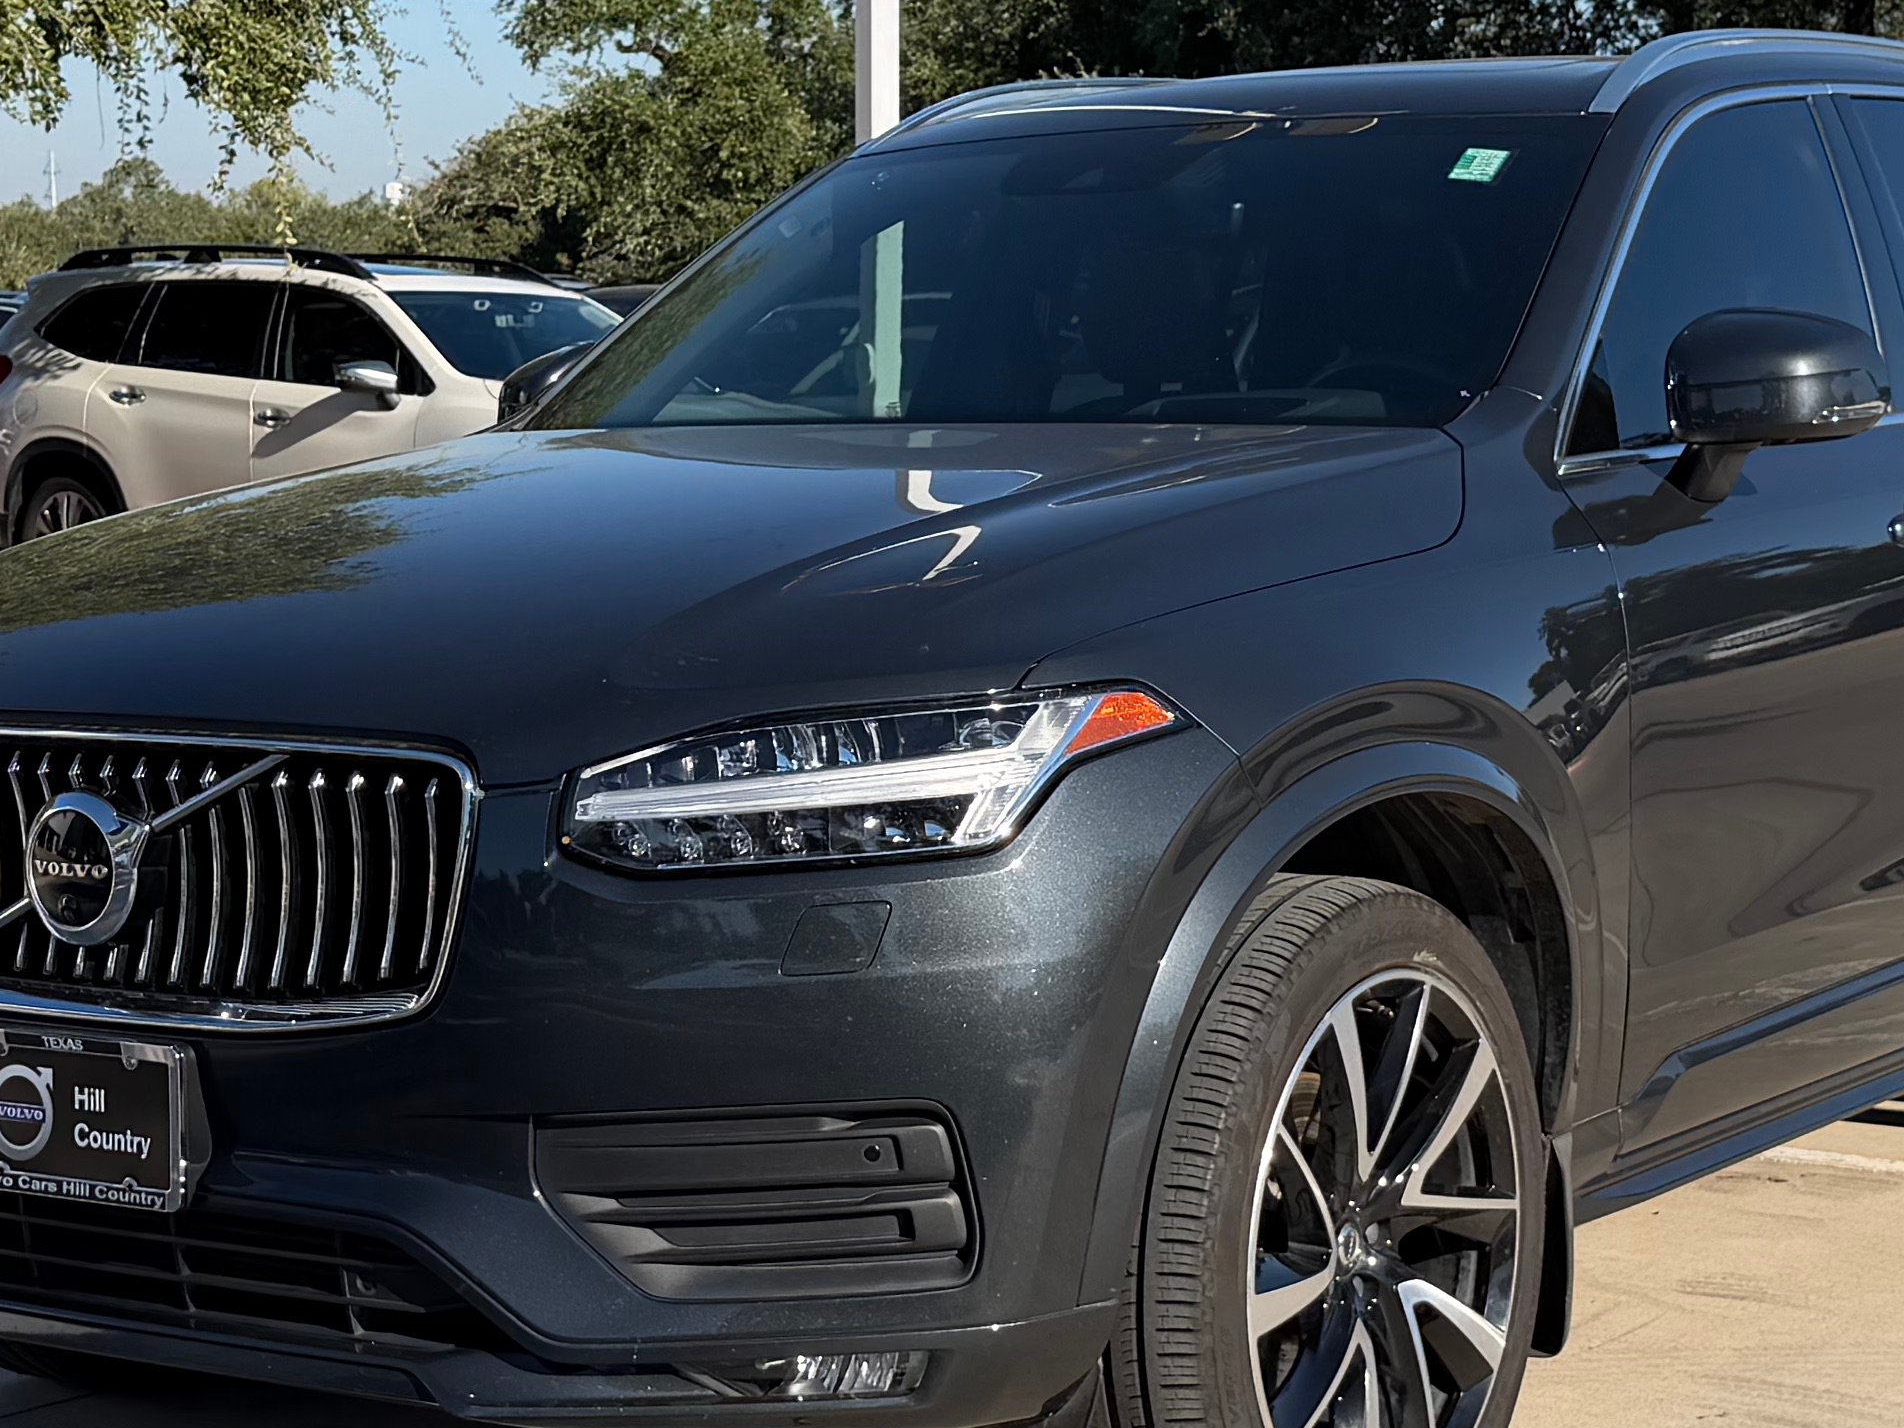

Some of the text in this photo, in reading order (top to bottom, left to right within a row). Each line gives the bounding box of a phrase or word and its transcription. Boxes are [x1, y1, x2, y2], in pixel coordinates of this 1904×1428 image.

[34, 859, 108, 880] VOLVO
[42, 1035, 84, 1052] TEXAS
[74, 1086, 105, 1113] Hill
[74, 1122, 151, 1159] Country
[17, 1175, 57, 1193] Cars
[62, 1181, 90, 1198] Hill
[94, 1185, 164, 1209] Country
